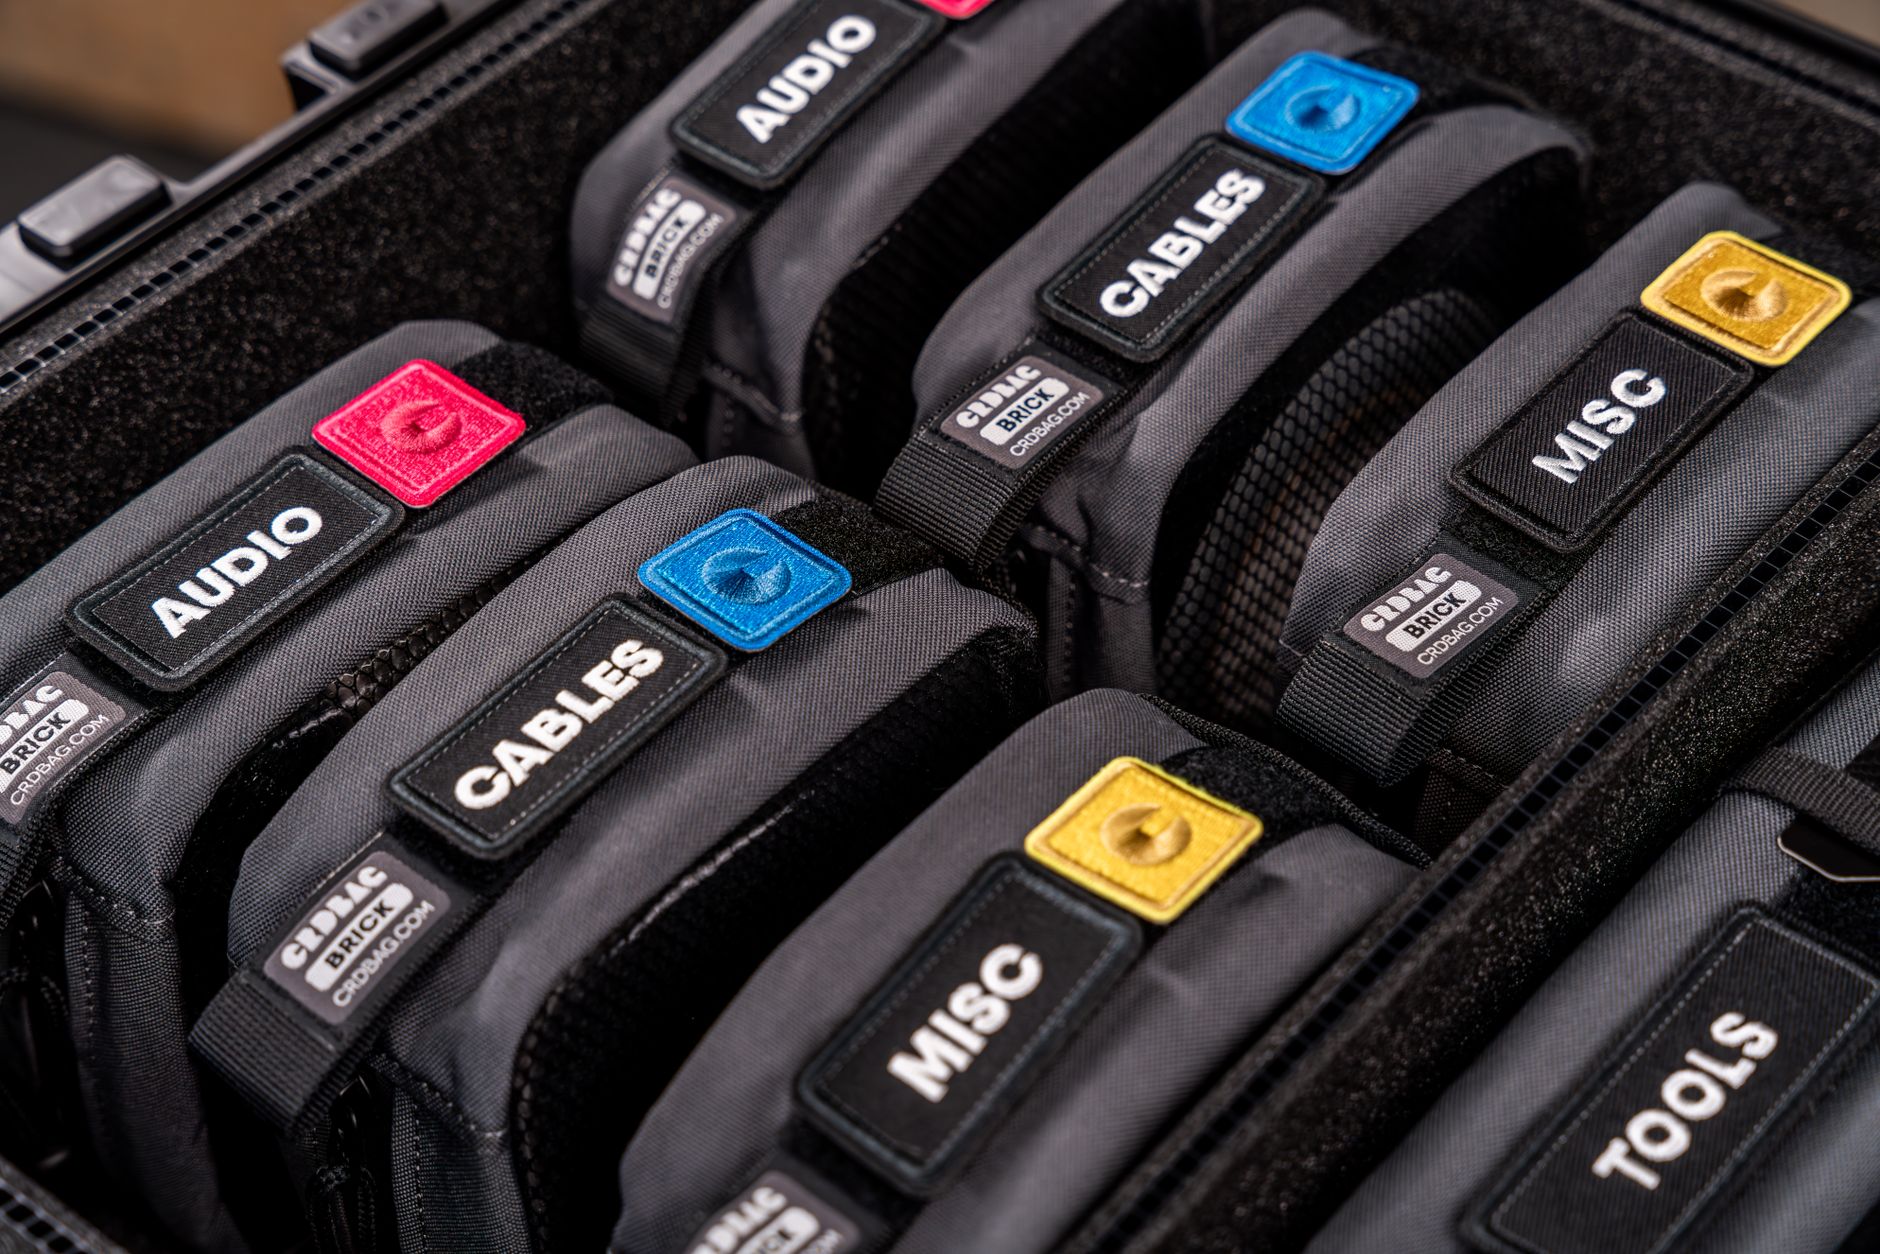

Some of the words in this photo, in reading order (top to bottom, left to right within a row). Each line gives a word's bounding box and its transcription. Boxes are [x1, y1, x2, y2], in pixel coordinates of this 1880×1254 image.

[737, 15, 876, 143] AUDIO
[645, 216, 687, 279] BRICK
[1100, 168, 1265, 317] CABLES
[956, 365, 1041, 428] CRDBAG
[996, 388, 1054, 432] BRICK
[1010, 391, 1090, 456] CRDBAG.COM
[1532, 369, 1666, 484] MISC
[151, 506, 322, 638] AUDIO
[1361, 566, 1451, 631] CRDBAG
[1403, 592, 1467, 639] BRICK
[1417, 597, 1504, 665] CRDBAG.COM
[0, 685, 64, 746] BAG
[1, 712, 71, 775] BRICK
[455, 639, 663, 809] CABLES
[11, 714, 110, 805] CRDBAG.COM
[281, 866, 387, 969] CRDBAG
[325, 899, 393, 970] BRICK
[333, 900, 435, 1007] CRDBAG.COM
[887, 943, 1043, 1103] MISC
[1592, 1012, 1778, 1190] TOOLS
